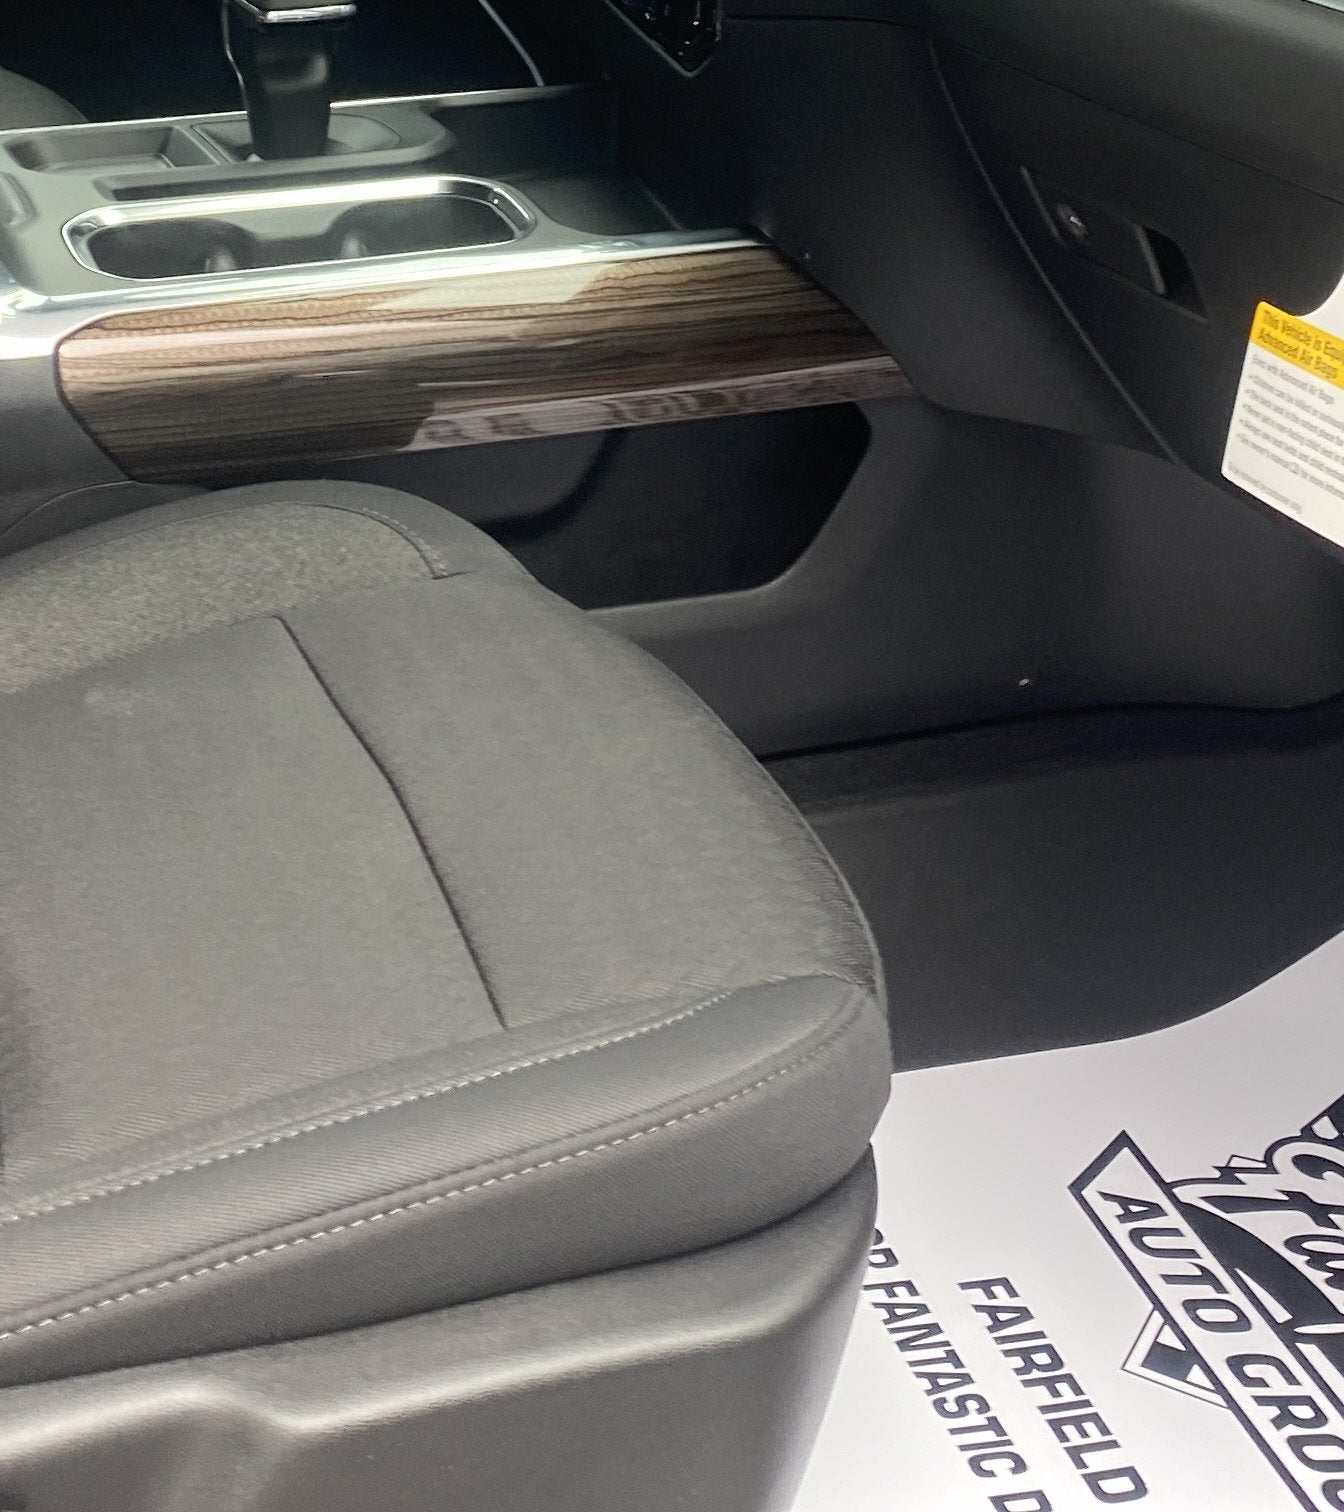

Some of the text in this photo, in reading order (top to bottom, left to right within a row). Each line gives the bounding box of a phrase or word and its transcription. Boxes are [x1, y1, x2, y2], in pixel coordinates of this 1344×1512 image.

[1097, 1191, 1252, 1334] AUTO
[862, 1279, 1028, 1479] FANTASTIC
[956, 1276, 1150, 1505] FAIRFIELD
